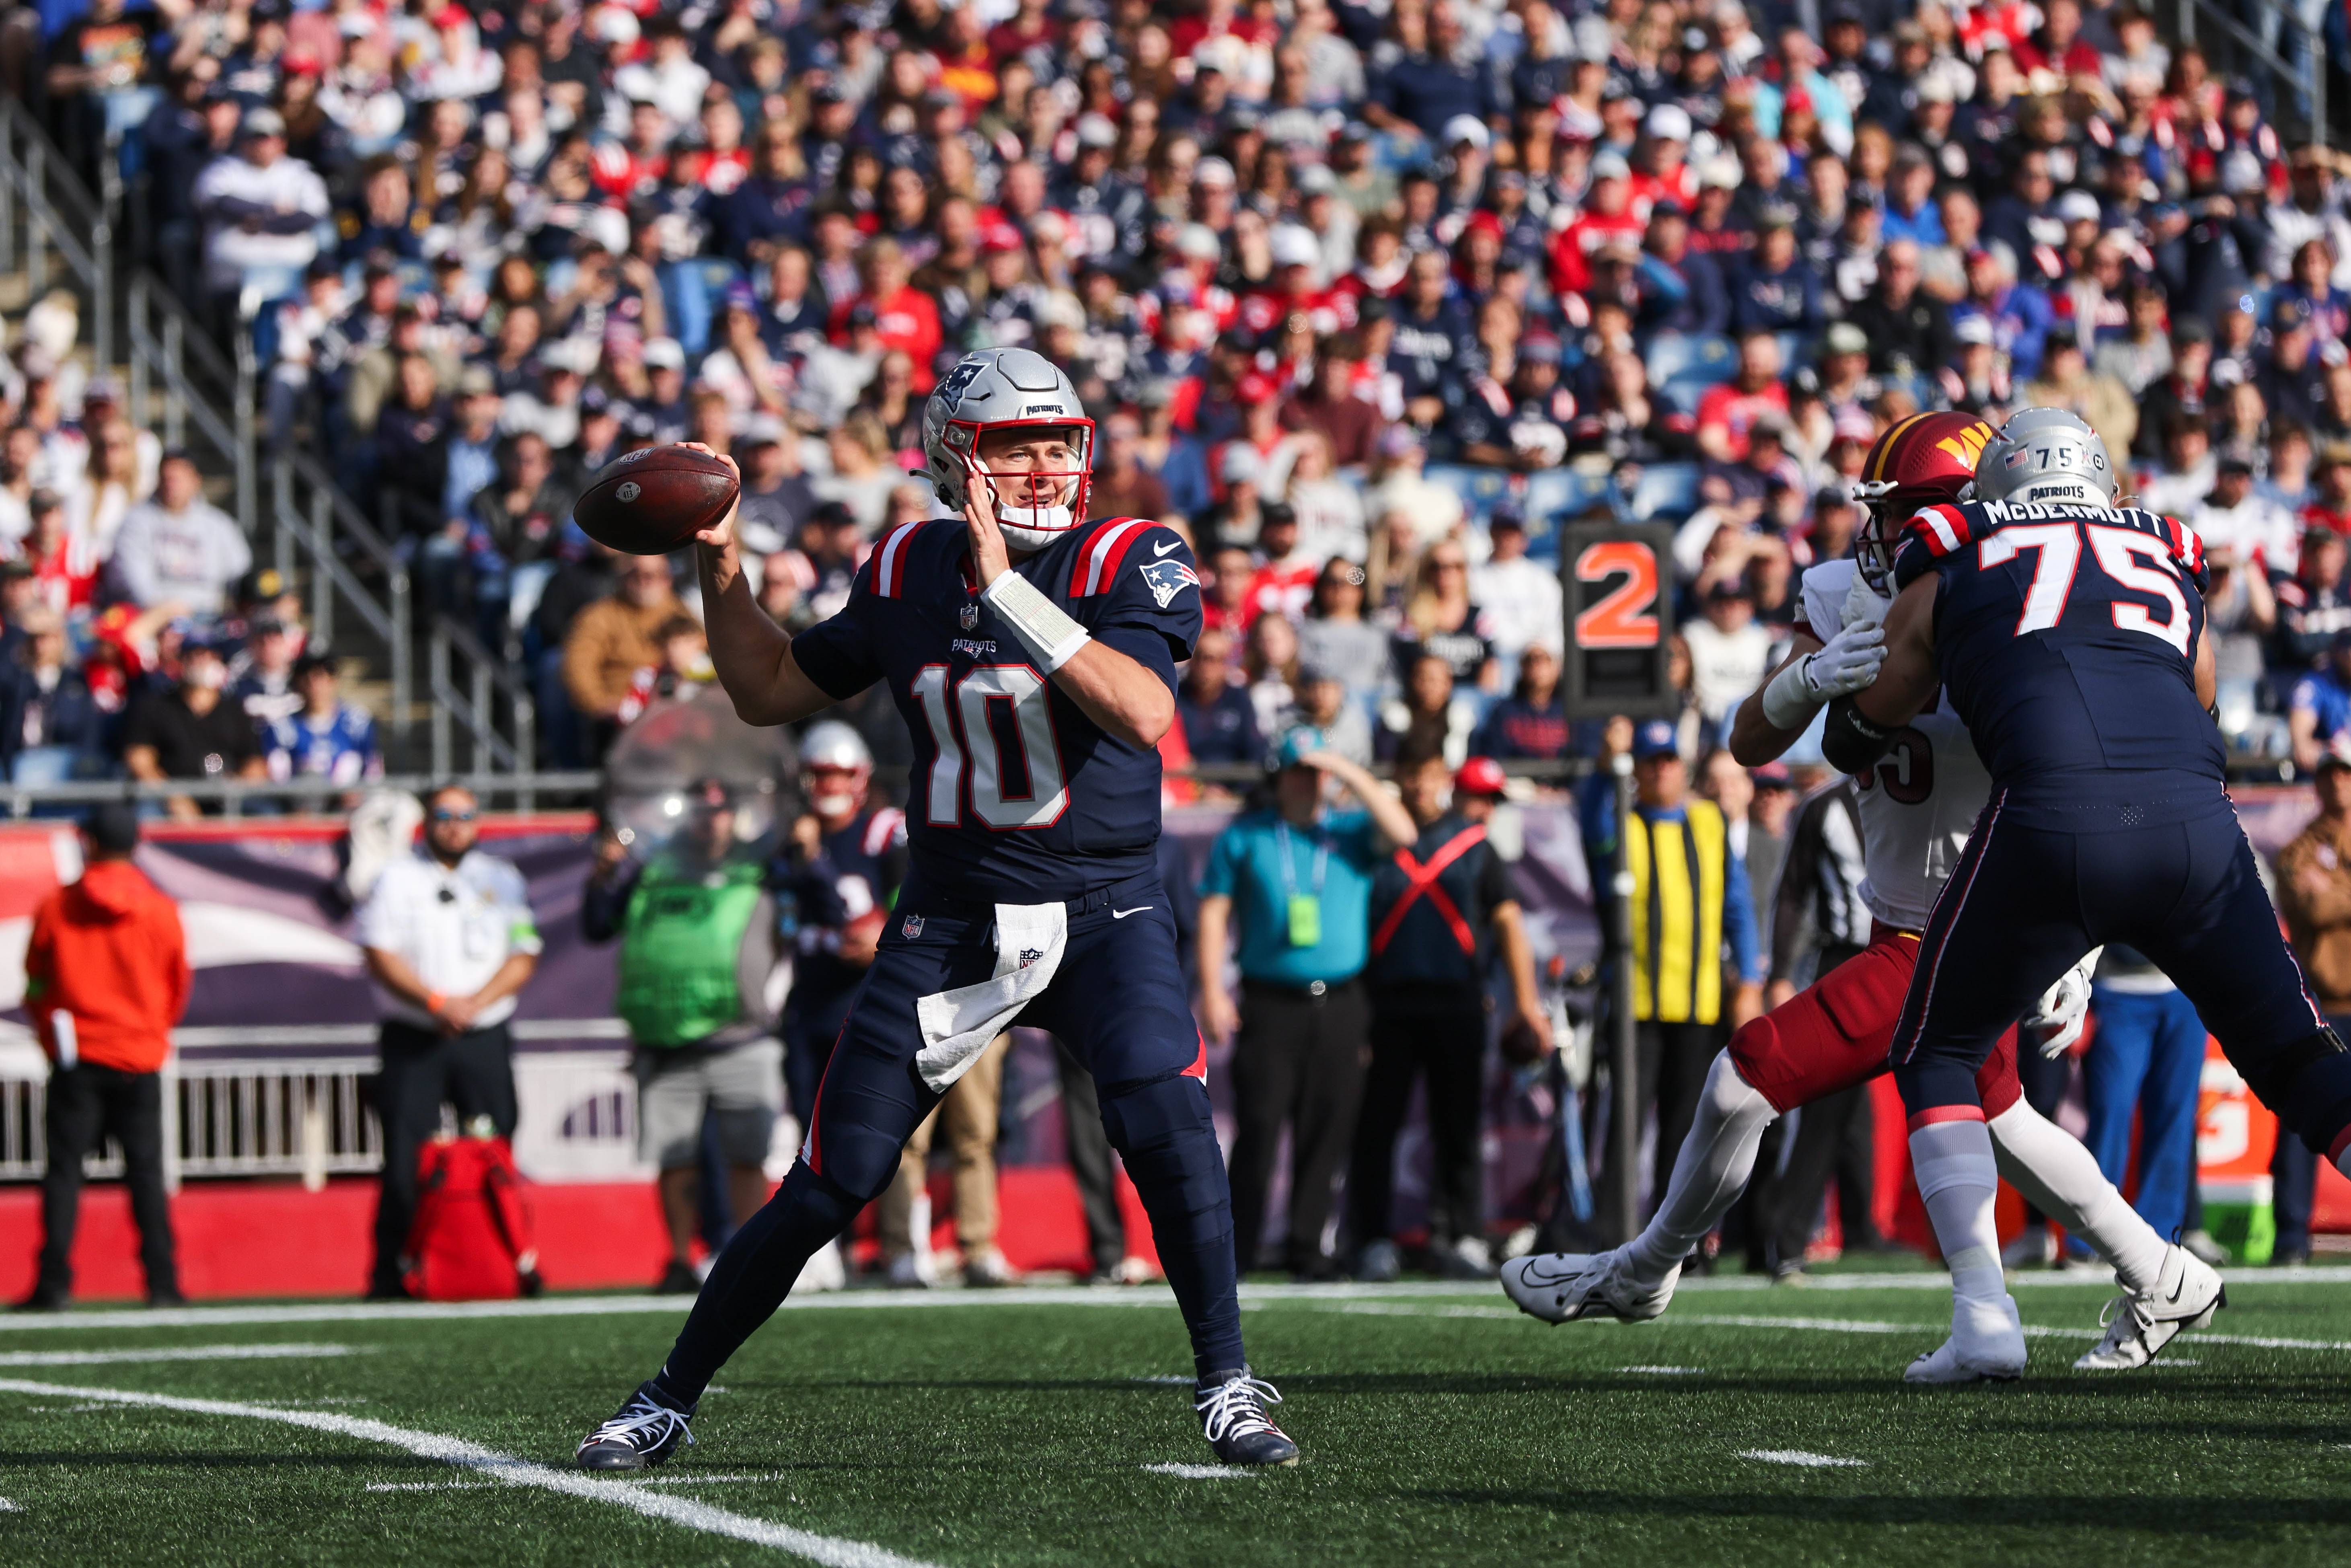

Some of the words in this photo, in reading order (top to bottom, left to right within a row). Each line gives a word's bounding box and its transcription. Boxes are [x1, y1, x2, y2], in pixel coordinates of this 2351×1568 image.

[1026, 405, 1063, 416] PATRIOTS
[622, 449, 647, 461] NFL
[624, 490, 633, 499] 413
[2031, 486, 2084, 501] PATRIOTS
[1575, 541, 1660, 649] 2
[1978, 522, 2191, 658] 75
[963, 615, 974, 625] NFL
[951, 639, 996, 653] PATRIOTS
[910, 664, 1070, 831] 10
[904, 924, 918, 935] NFL
